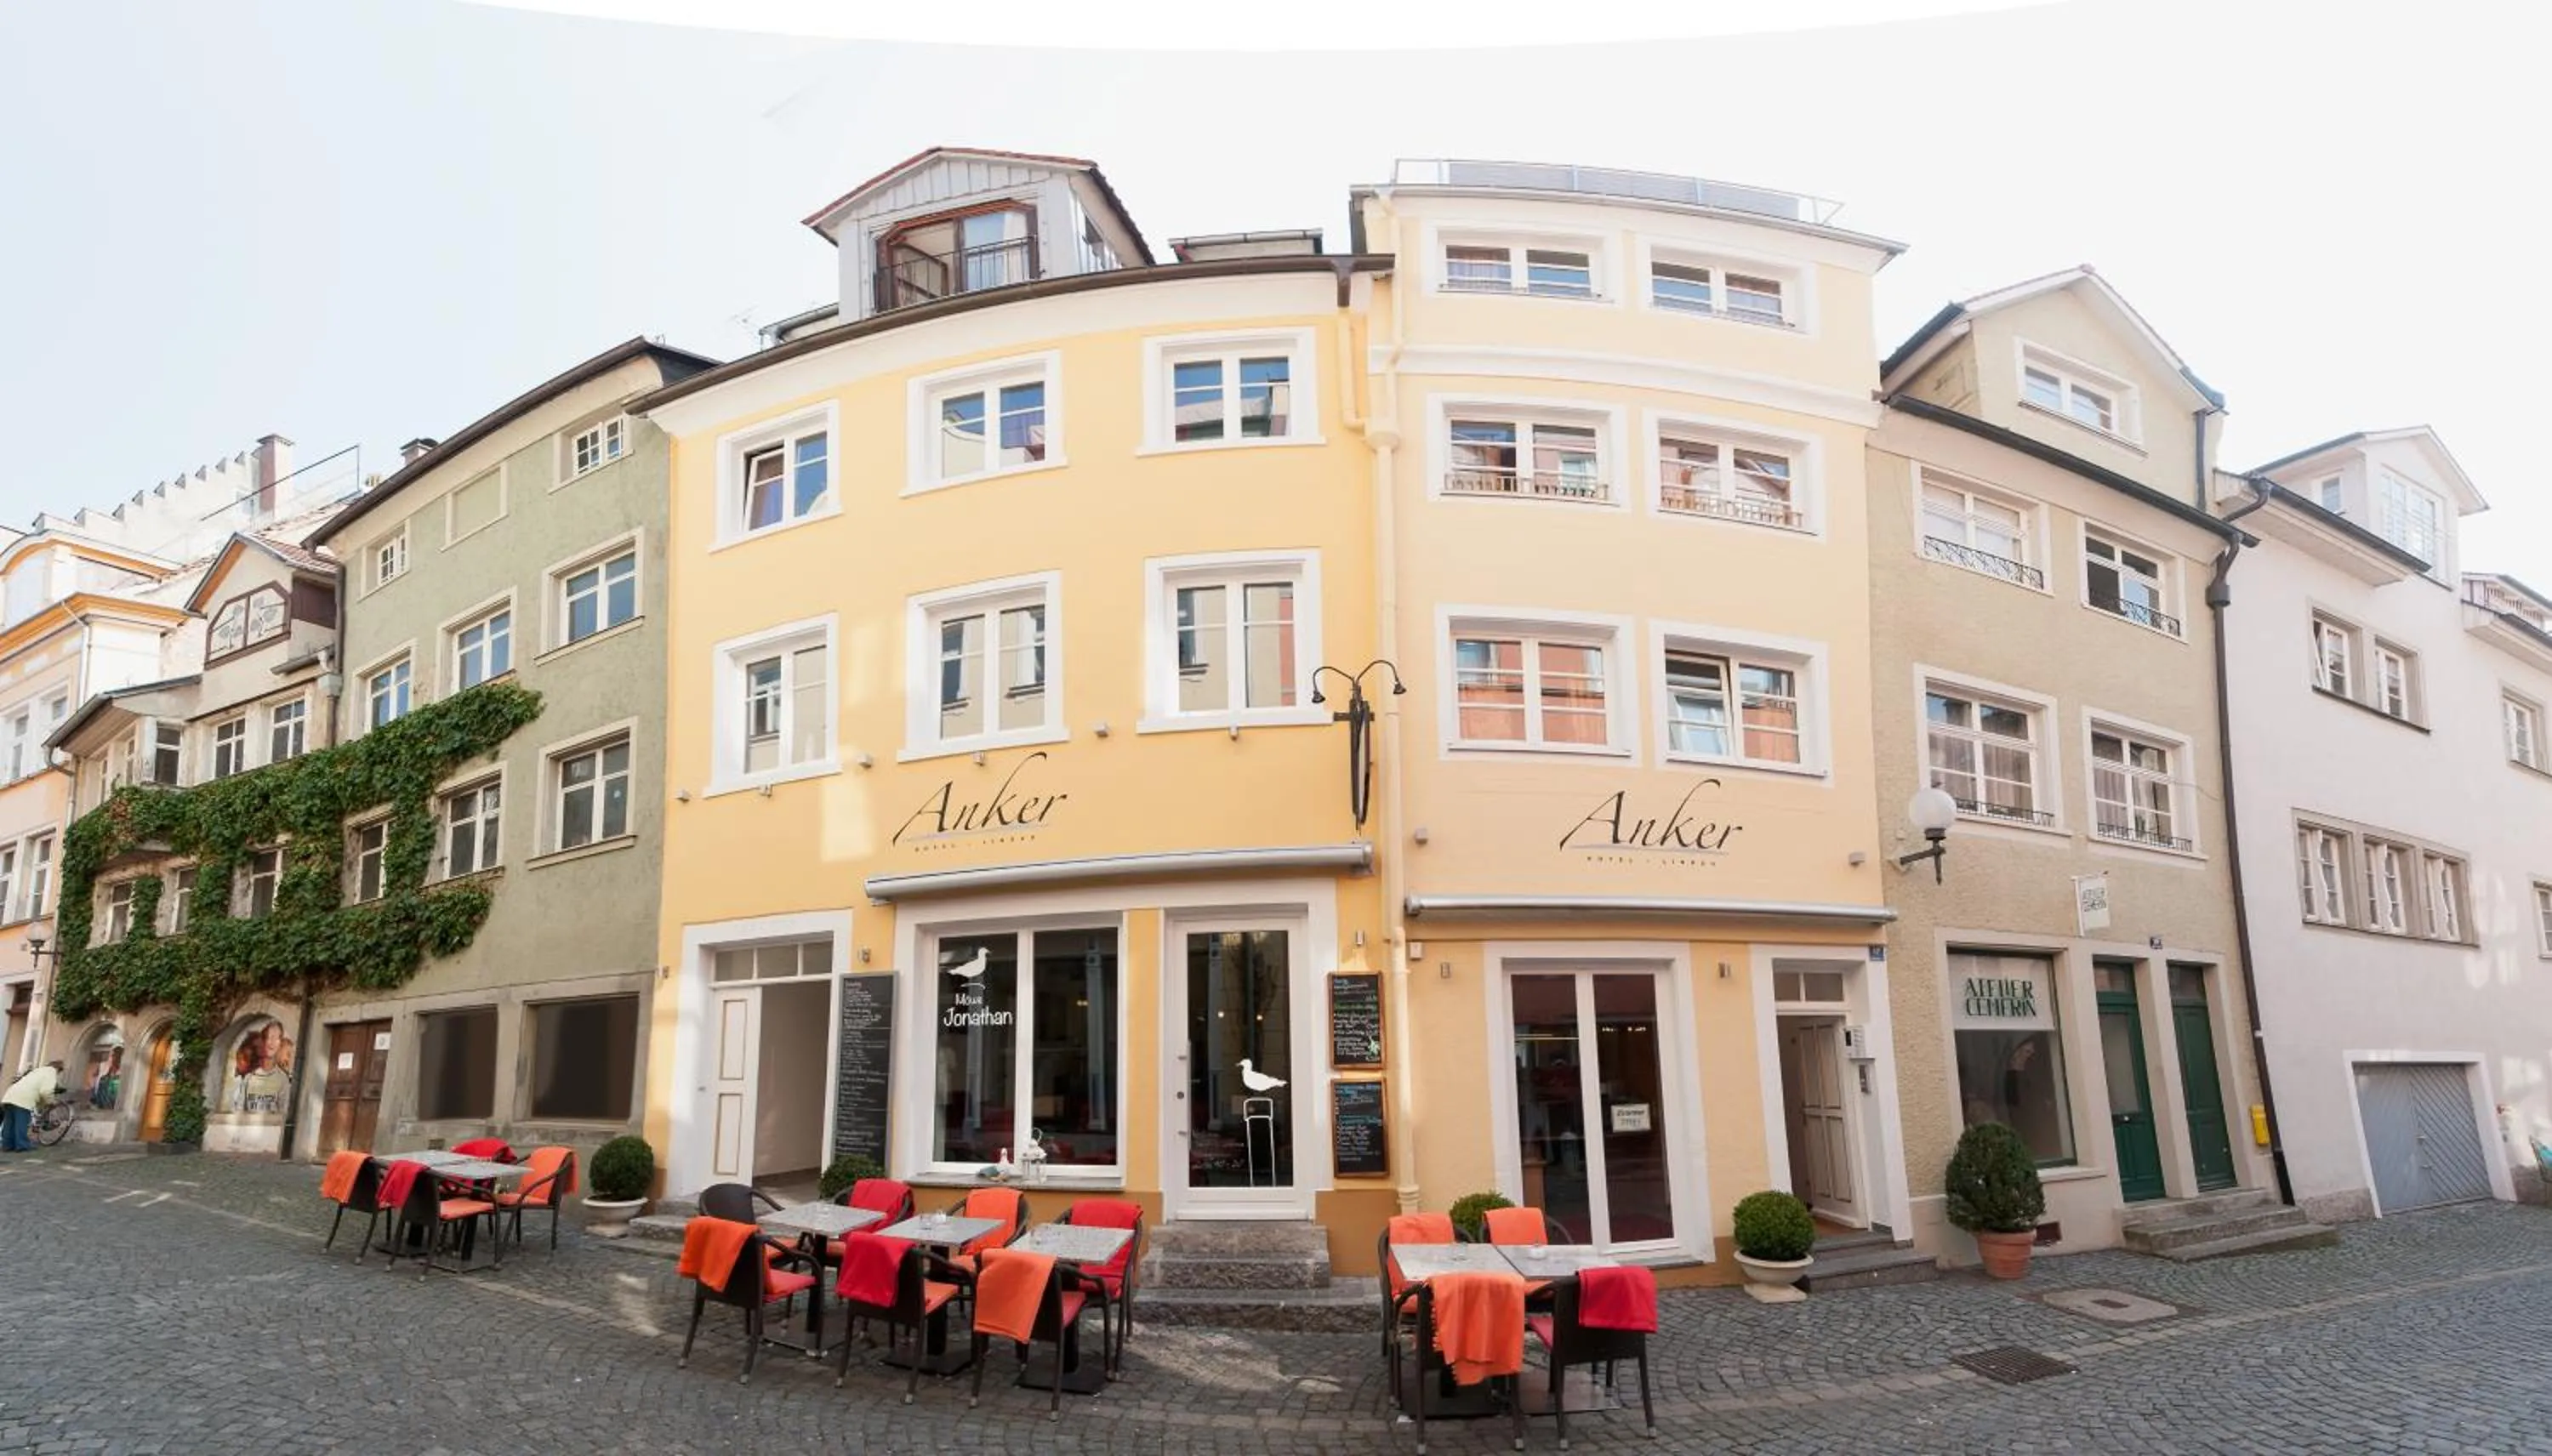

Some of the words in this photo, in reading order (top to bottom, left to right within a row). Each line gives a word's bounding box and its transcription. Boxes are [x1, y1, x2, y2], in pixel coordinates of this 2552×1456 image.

[892, 751, 1068, 846] Anker
[1559, 778, 1743, 850] Anker
[1965, 977, 2034, 998] ATELIER
[943, 1005, 1013, 1027] Jonathan
